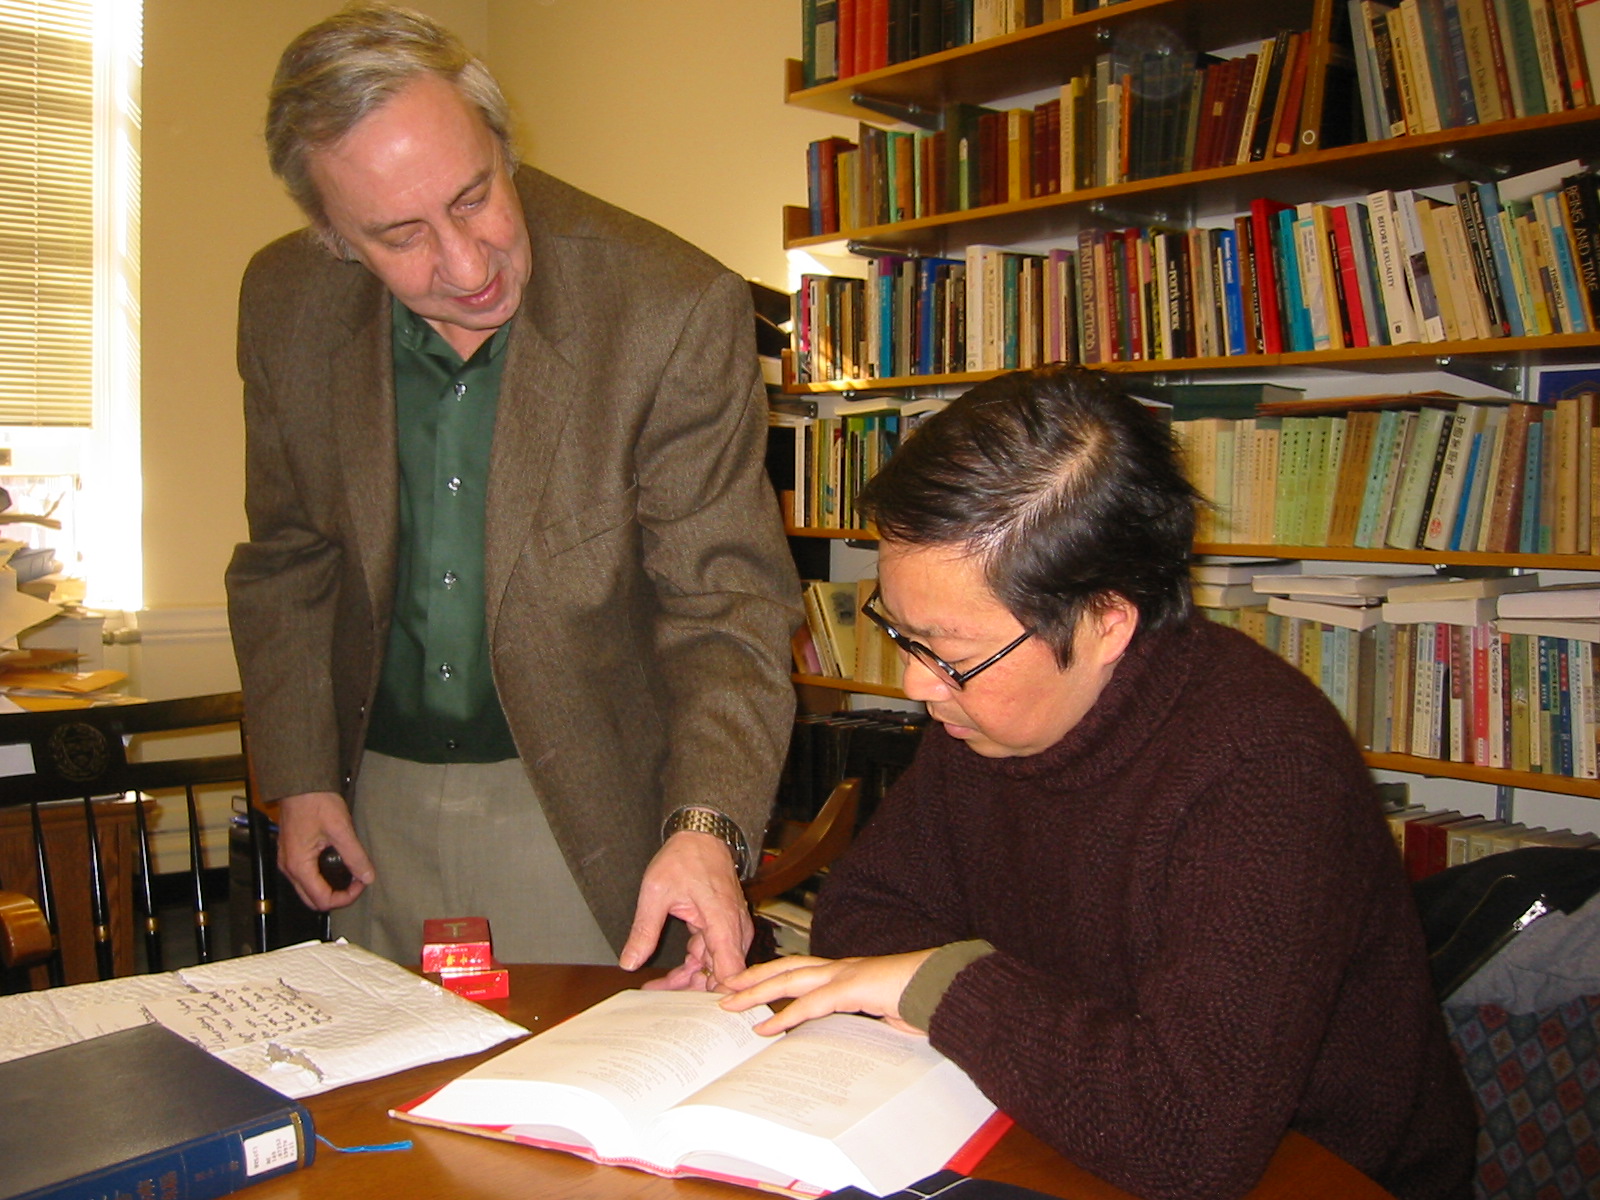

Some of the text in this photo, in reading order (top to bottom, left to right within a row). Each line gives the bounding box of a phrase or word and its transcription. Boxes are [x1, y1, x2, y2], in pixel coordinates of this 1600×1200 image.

[1377, 215, 1395, 289] BEFORE SEXUALITY
[1566, 185, 1598, 292] BEING AND TIME
[1080, 240, 1096, 350] TRUTH AND METHOD
[1170, 300, 1180, 330] WORK
